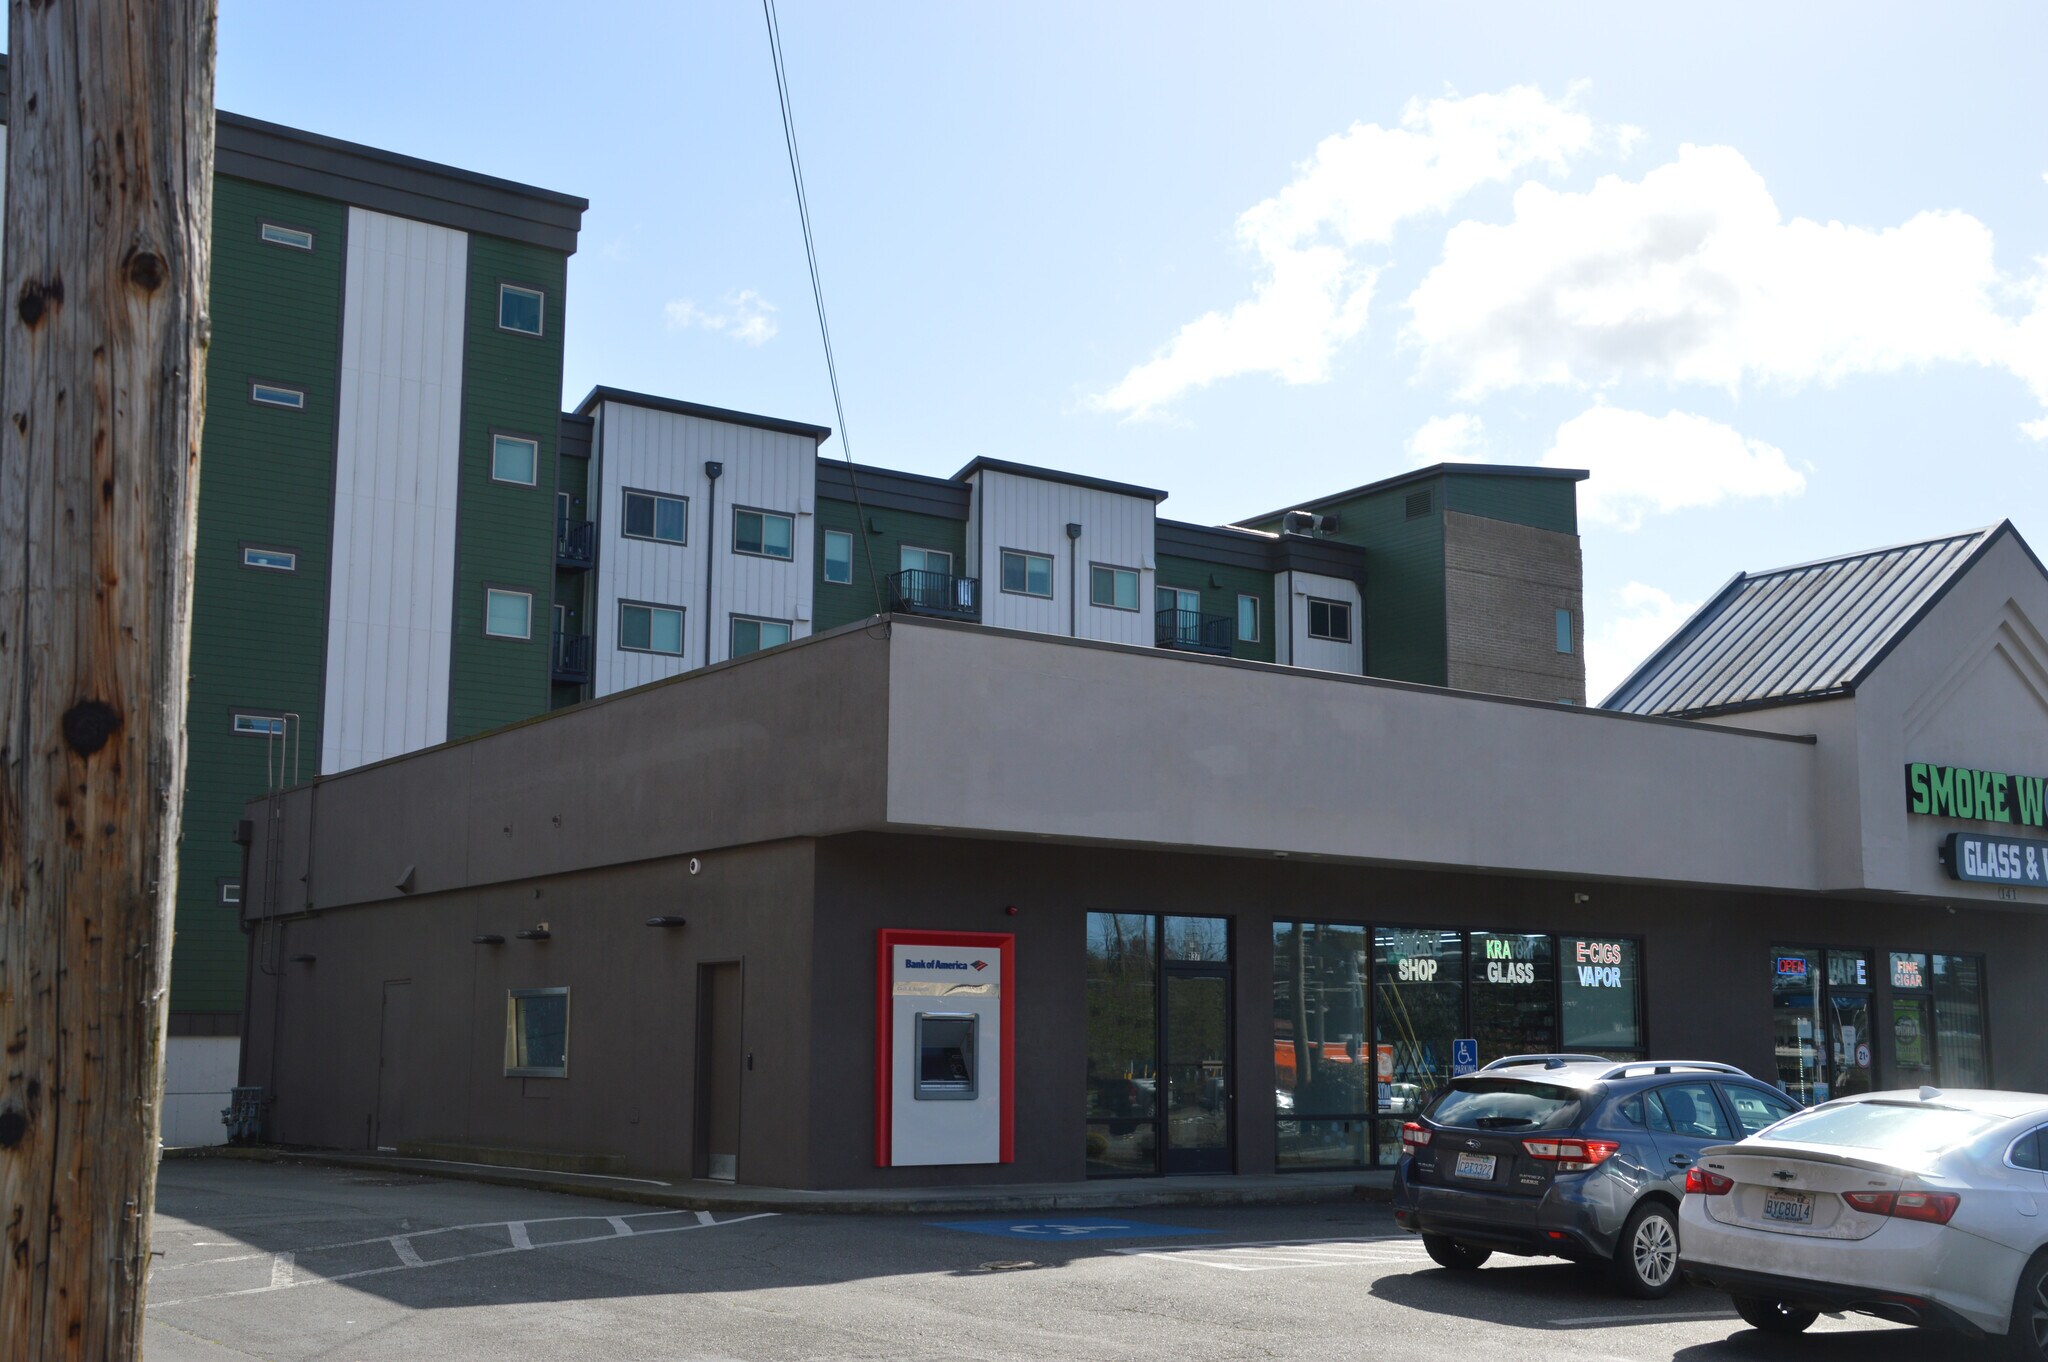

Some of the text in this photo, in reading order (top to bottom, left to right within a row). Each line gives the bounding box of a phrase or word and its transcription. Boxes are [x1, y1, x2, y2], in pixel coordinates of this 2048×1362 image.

[1909, 762, 2048, 829] SMOKE W
[1963, 840, 2021, 879] GLASS
[2025, 846, 2040, 880] &
[1393, 931, 1443, 957] SMOKE
[1486, 939, 1534, 960] KRATOM
[1576, 941, 1621, 964] E-CIGS
[905, 959, 968, 970] Bank of America
[1398, 958, 1438, 982] SHOP
[1487, 961, 1535, 984] GLASS
[1779, 959, 1805, 973] OPEN
[1828, 957, 1867, 985] VAPE
[1897, 960, 1918, 974] FINE
[1577, 966, 1622, 988] VAPOR
[1894, 974, 1922, 988] CIGAR
[1455, 1064, 1476, 1074] PARKING
[1765, 1199, 1810, 1219] BYC8014
